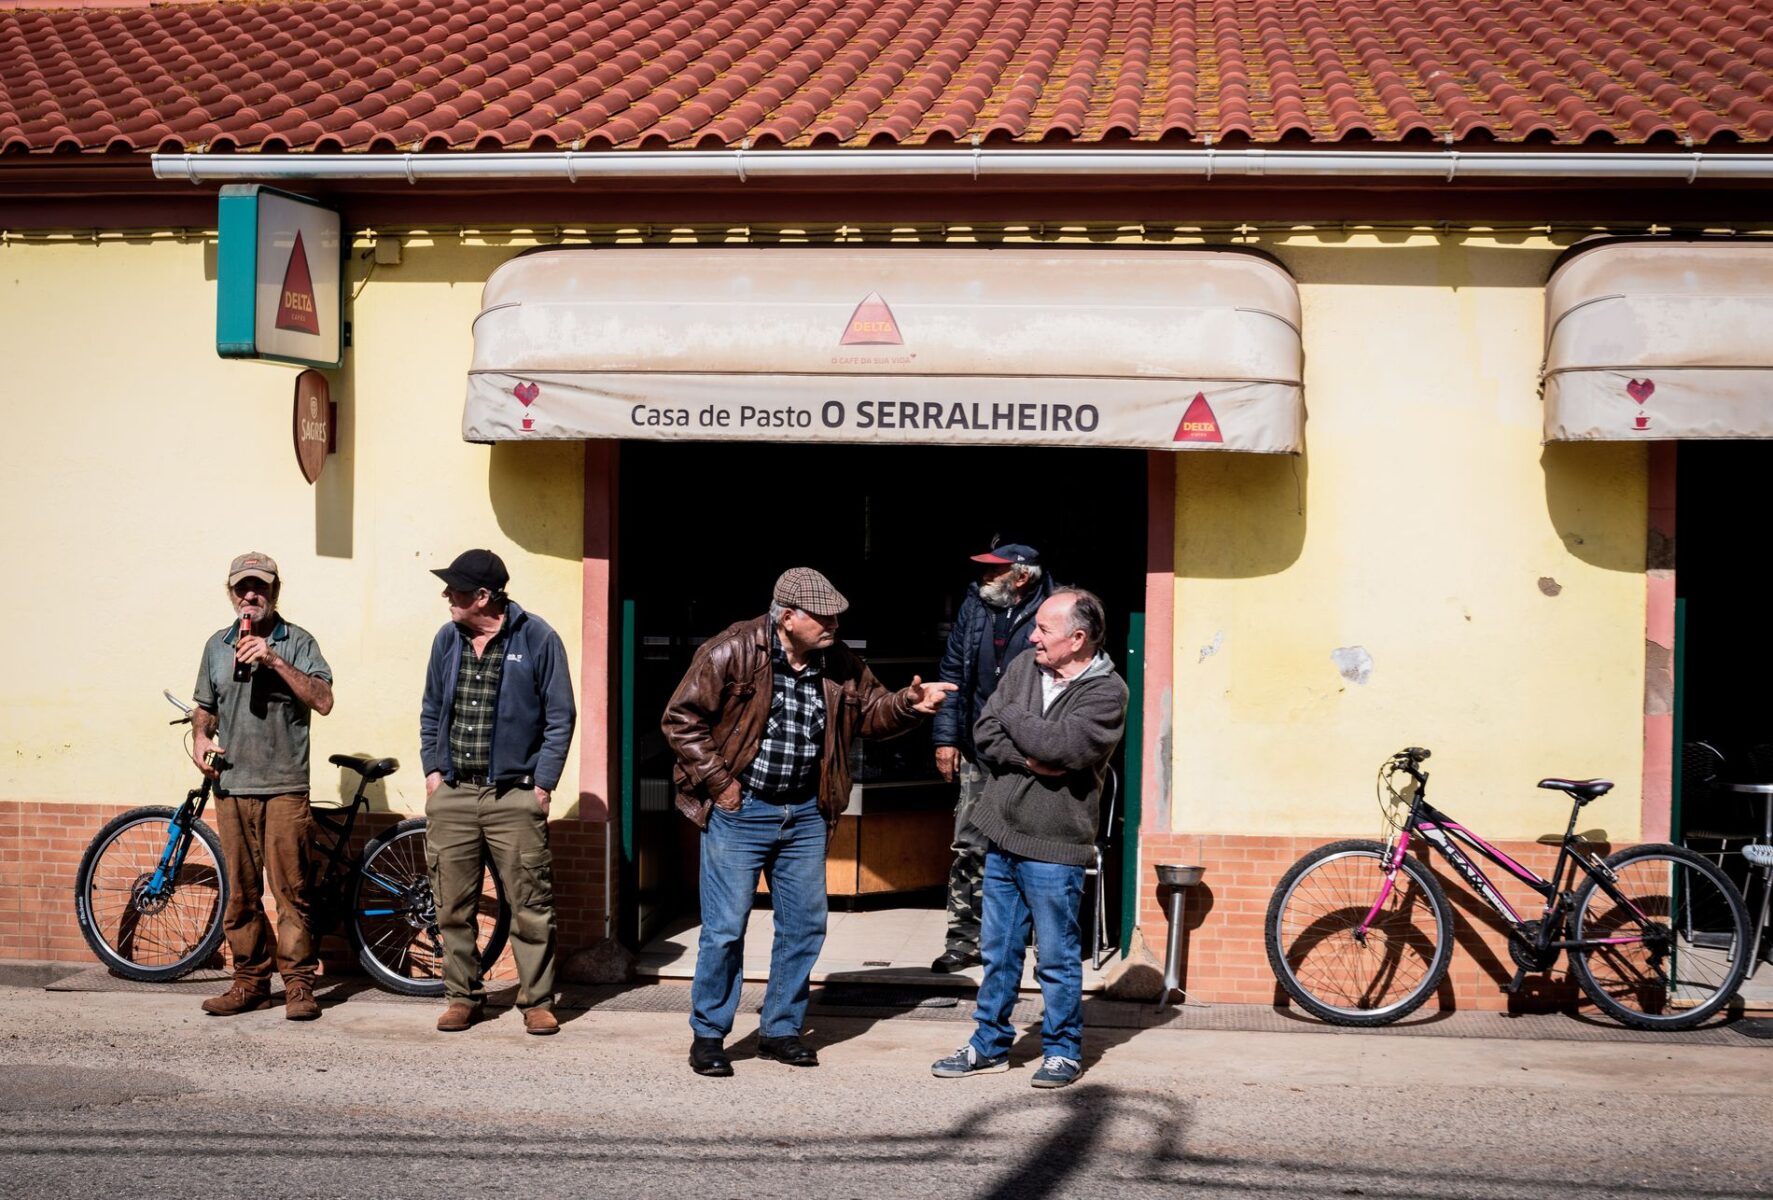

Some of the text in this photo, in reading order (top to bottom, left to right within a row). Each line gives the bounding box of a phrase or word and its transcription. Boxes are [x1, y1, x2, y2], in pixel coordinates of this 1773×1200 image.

[285, 291, 313, 313] DELTA
[853, 321, 892, 332] DELTA
[631, 400, 1100, 432] Casa de Pasto O SERRALHEIRO
[1183, 422, 1216, 432] DELTA
[301, 418, 327, 443] SAGRES
